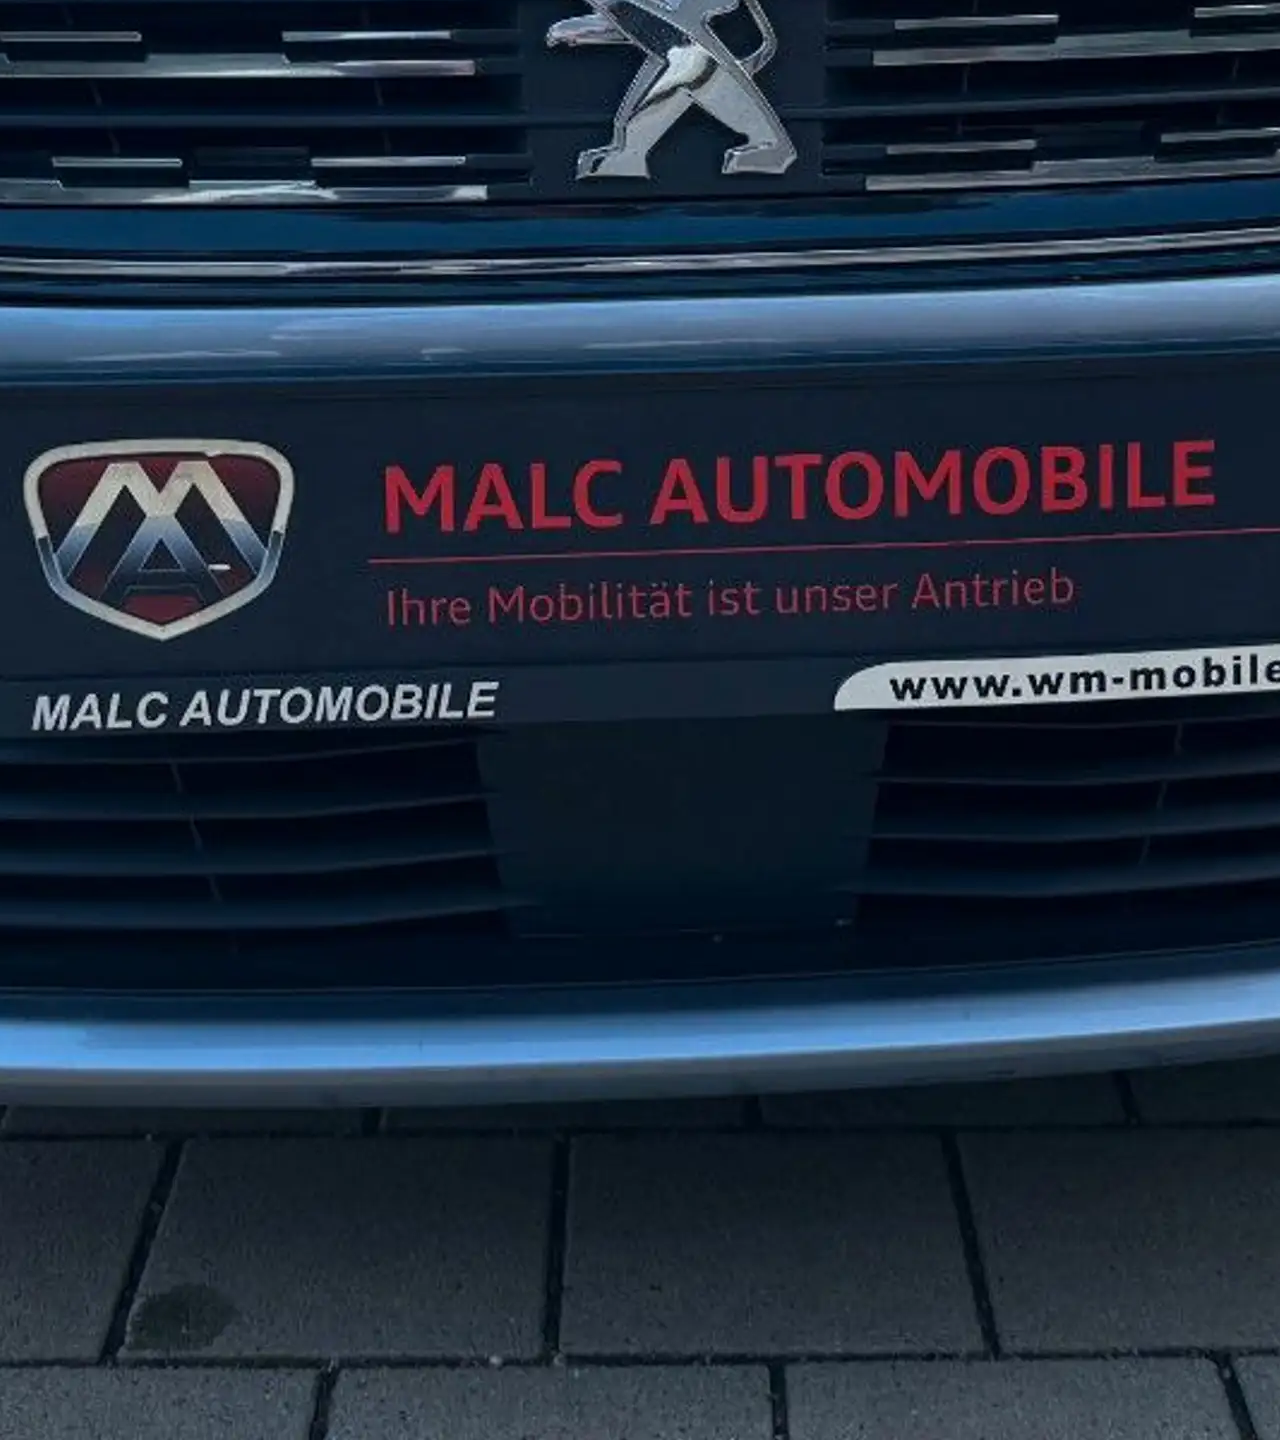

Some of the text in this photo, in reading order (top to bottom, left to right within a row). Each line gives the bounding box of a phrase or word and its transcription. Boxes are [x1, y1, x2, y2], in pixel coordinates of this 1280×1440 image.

[383, 439, 1217, 533] MALC AUTOMOBILE
[387, 566, 1074, 626] Ihre Mobilität ist unser Antrieb
[30, 681, 500, 731] MALC AUTOMOBILE
